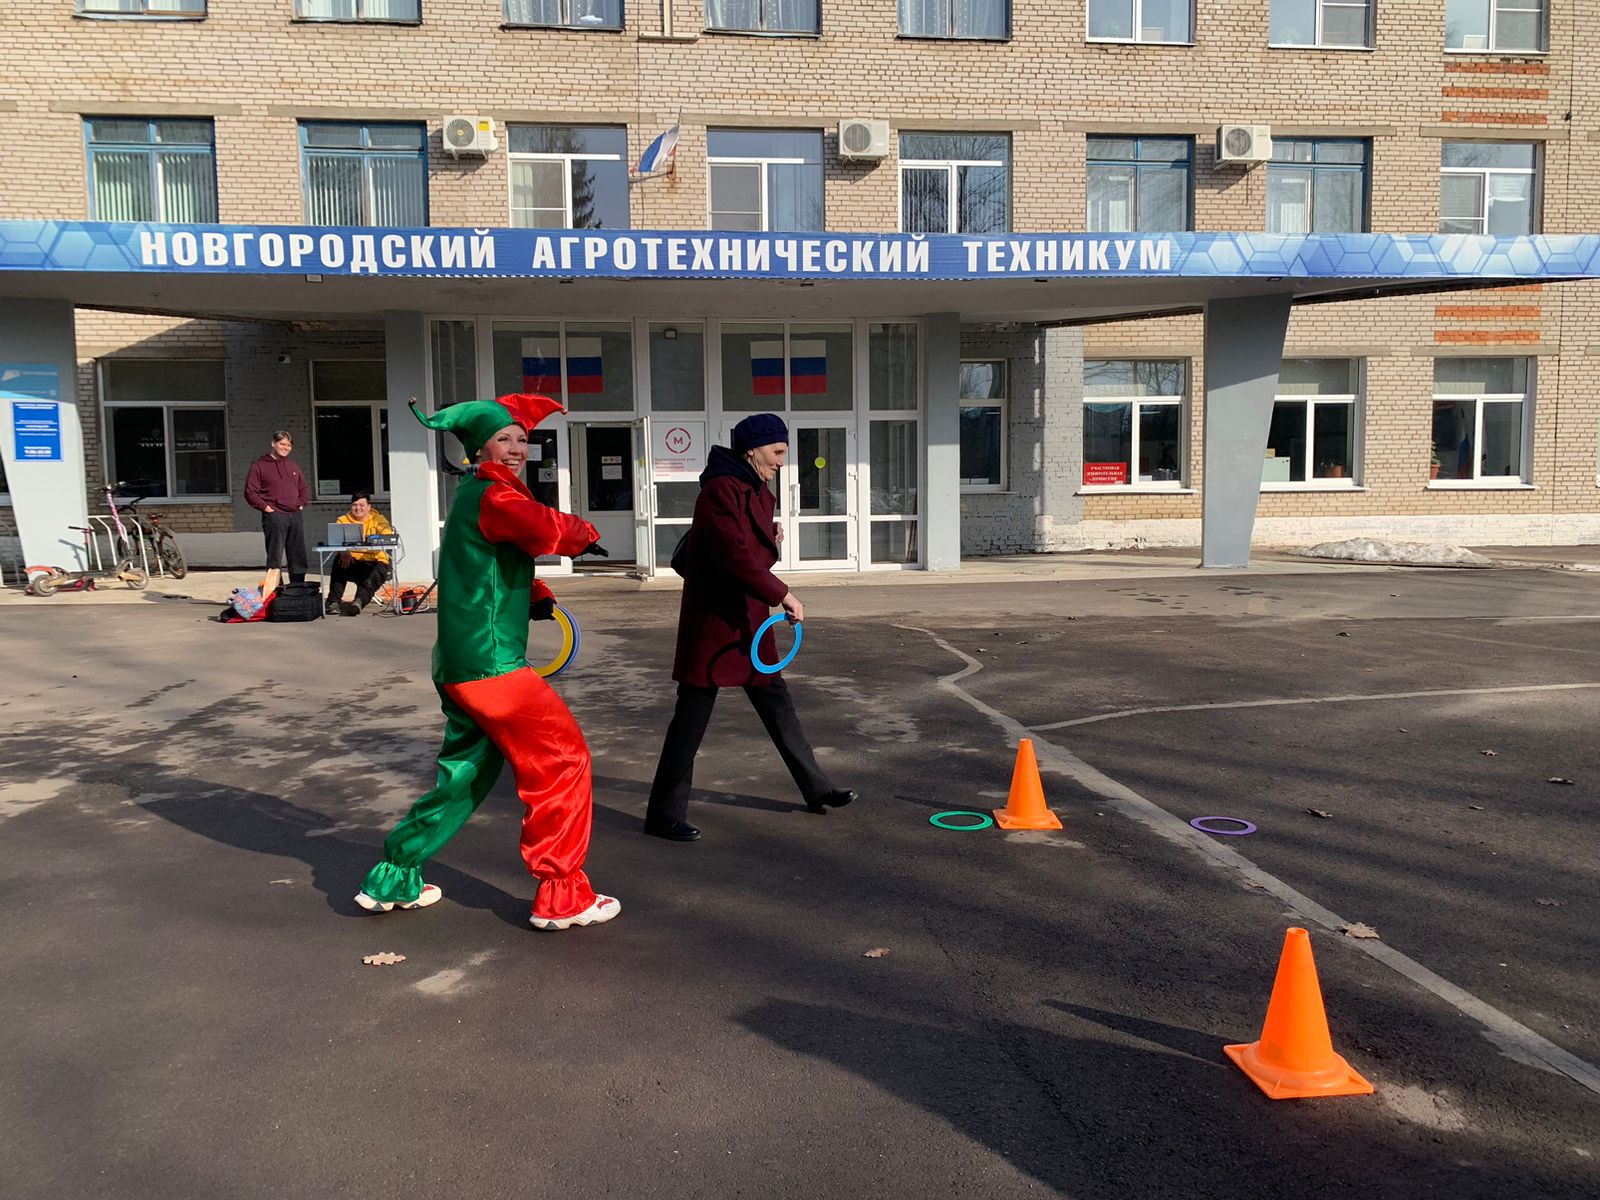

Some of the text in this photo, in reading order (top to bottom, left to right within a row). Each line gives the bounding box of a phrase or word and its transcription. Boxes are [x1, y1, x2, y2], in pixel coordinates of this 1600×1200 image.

[139, 228, 1172, 273] НОВГОРОДСКИЙ АГРОТЕХНИЧЕСКИЙ ТЕХНИКУМ
